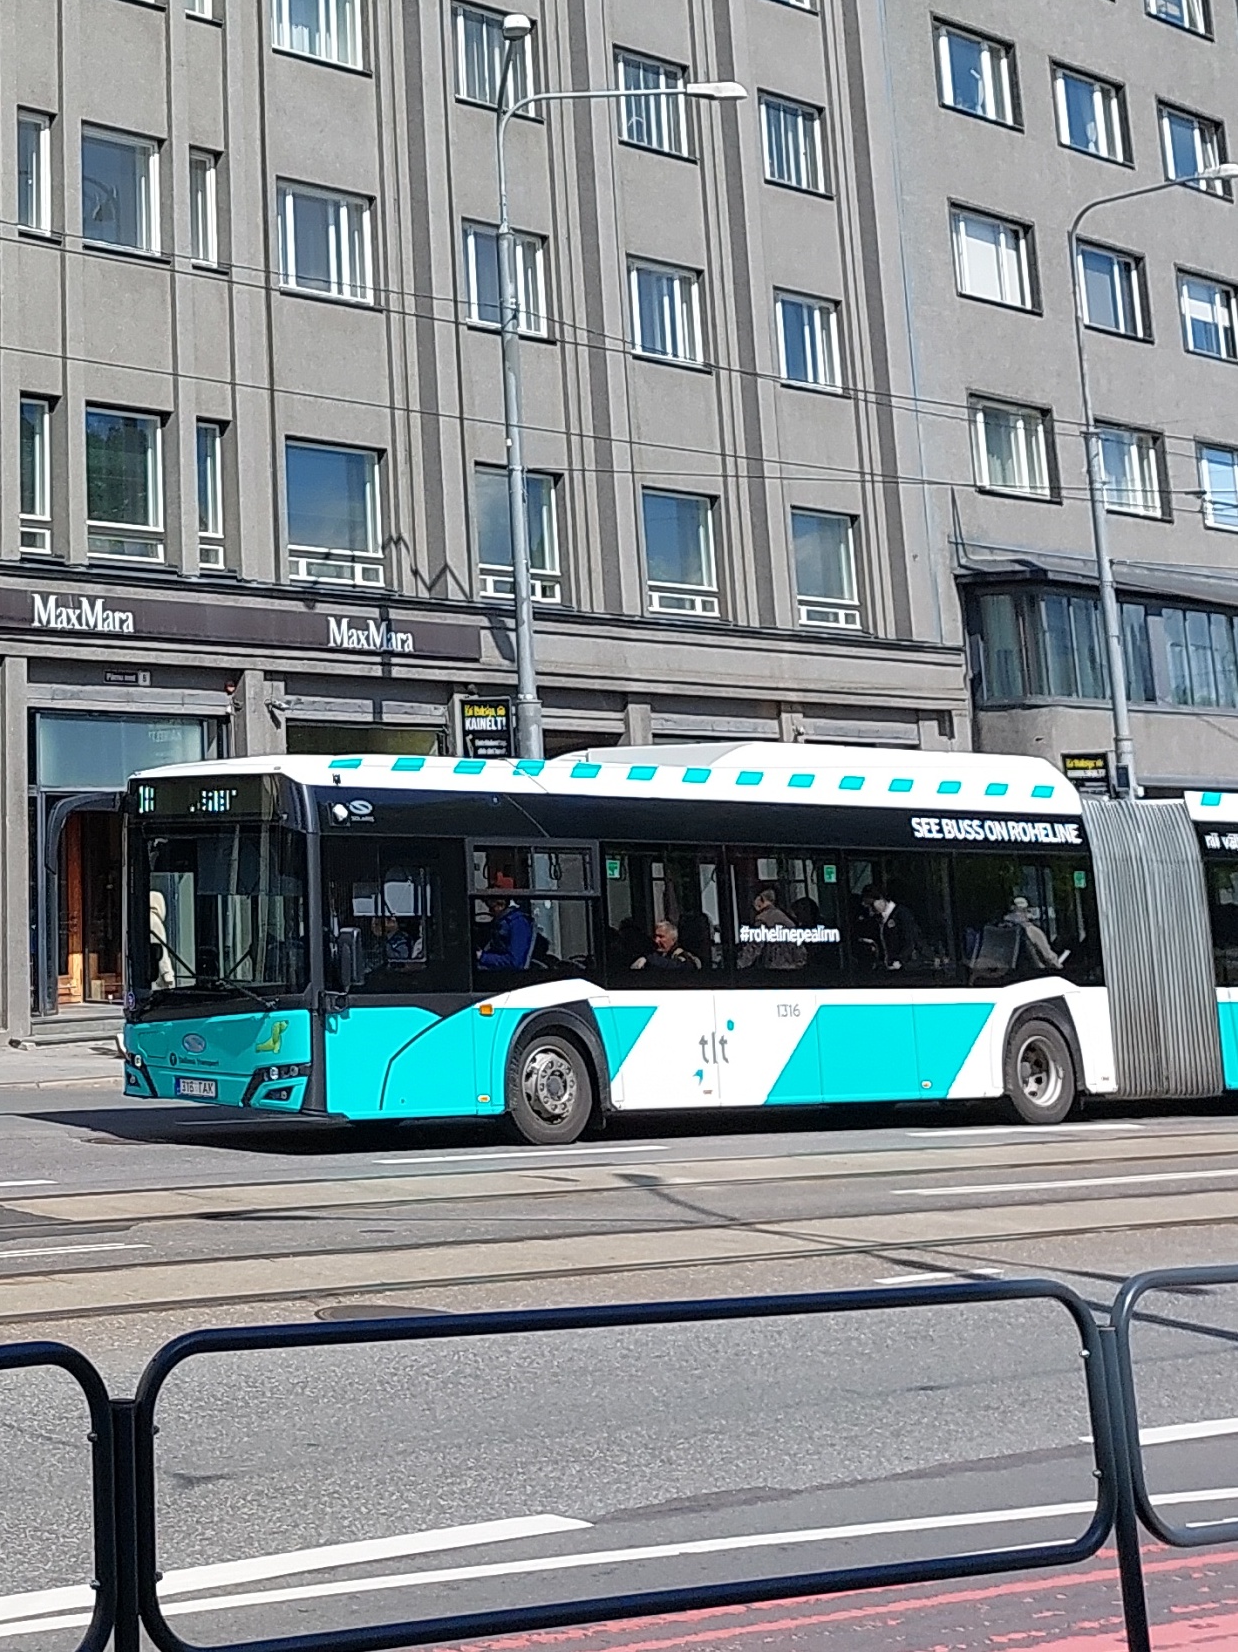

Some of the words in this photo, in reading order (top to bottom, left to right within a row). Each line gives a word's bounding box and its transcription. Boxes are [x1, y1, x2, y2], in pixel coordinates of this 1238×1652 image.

[32, 593, 134, 634] MaxMara
[327, 616, 414, 653] MaxMara
[911, 817, 944, 839] SEE
[941, 819, 985, 841] BUSS
[984, 820, 1009, 842] ON
[1007, 821, 1083, 845] ROHELINE
[739, 924, 841, 947] #rohelinepealinn
[776, 1003, 801, 1018] 1316
[698, 1031, 730, 1065] tlt
